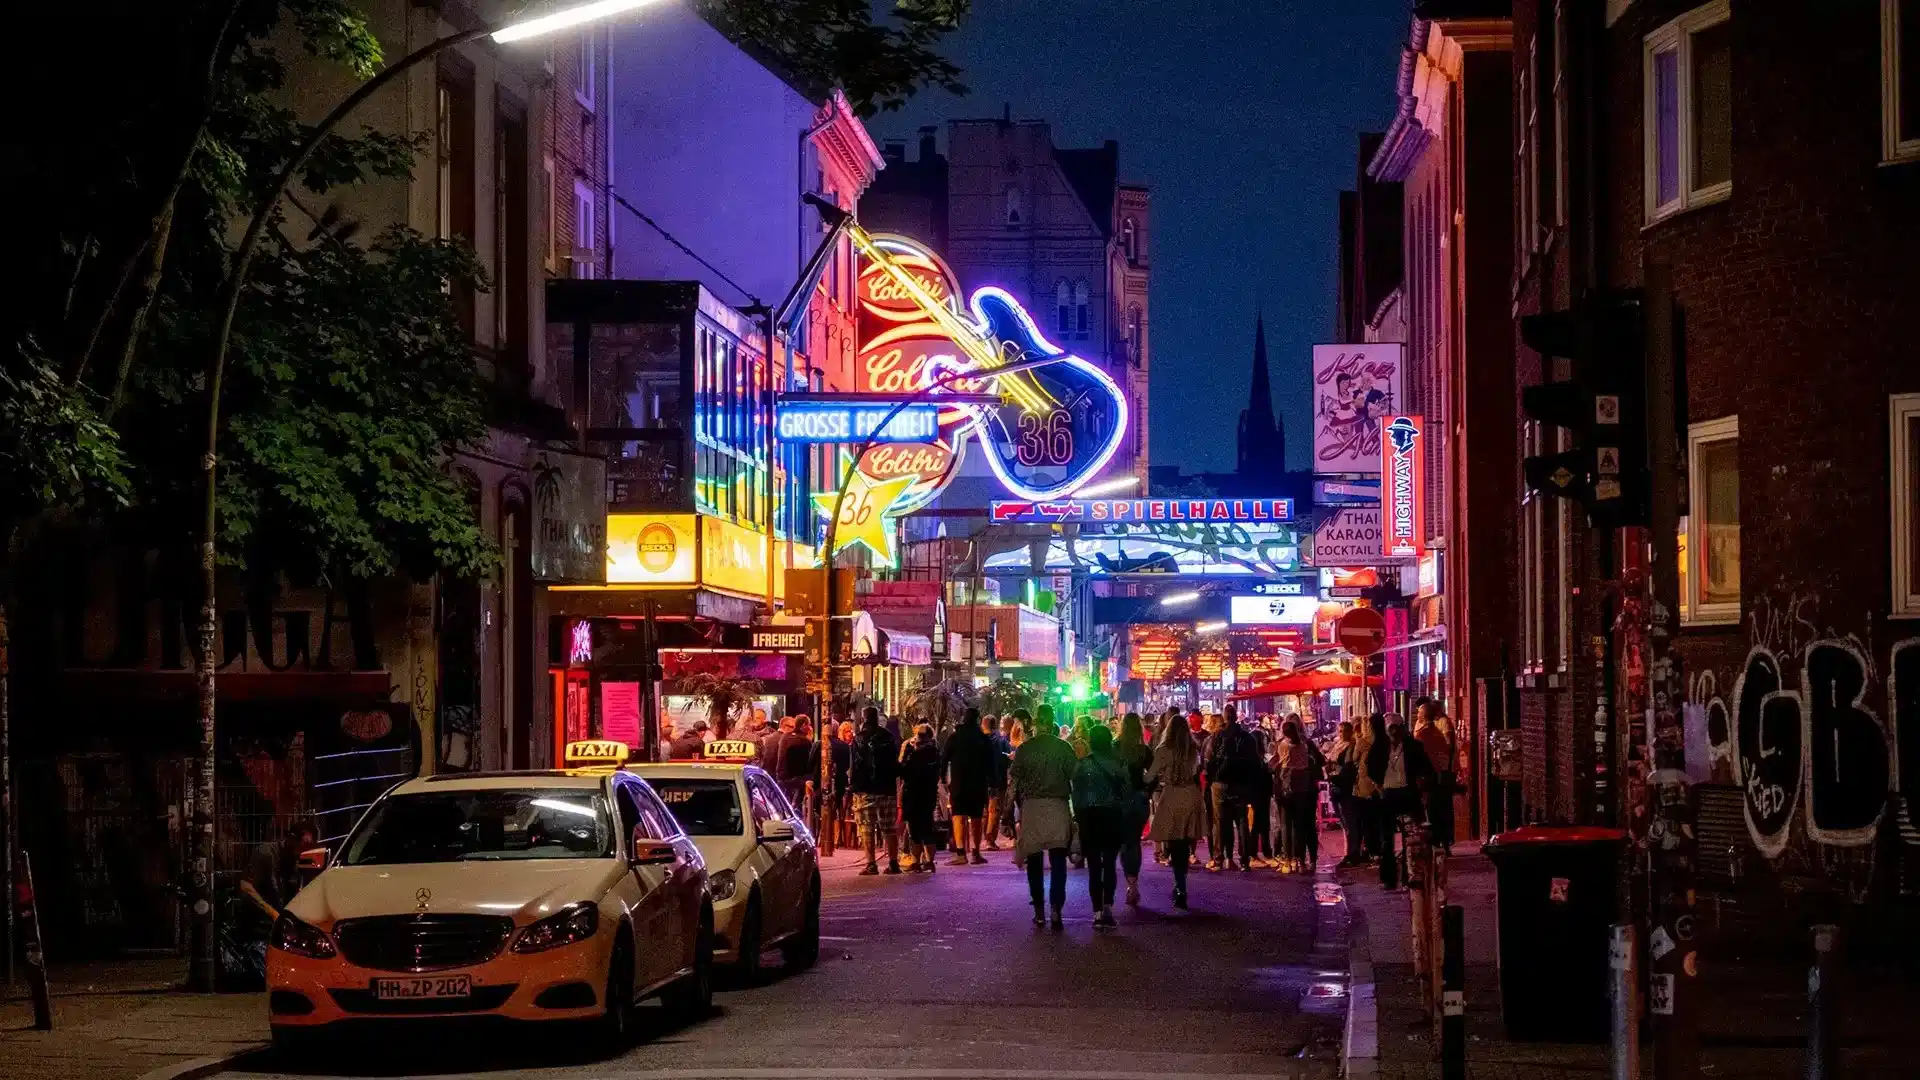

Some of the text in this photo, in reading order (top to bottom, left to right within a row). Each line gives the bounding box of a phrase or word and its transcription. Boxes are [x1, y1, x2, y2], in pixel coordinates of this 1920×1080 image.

[780, 411, 850, 438] GROSSE
[1017, 408, 1073, 467] 36
[870, 447, 945, 475] Colibri
[1396, 454, 1411, 536] HIGHWAY
[840, 491, 871, 526] 36
[1091, 500, 1290, 520] SPIELHALLE
[1344, 512, 1378, 525] THAI
[1326, 528, 1383, 541] KARAOK
[1316, 544, 1374, 556] COCKTAIL
[575, 743, 615, 757] TAXI
[711, 742, 744, 754] TAXI
[380, 978, 467, 997] HH ZP 202
